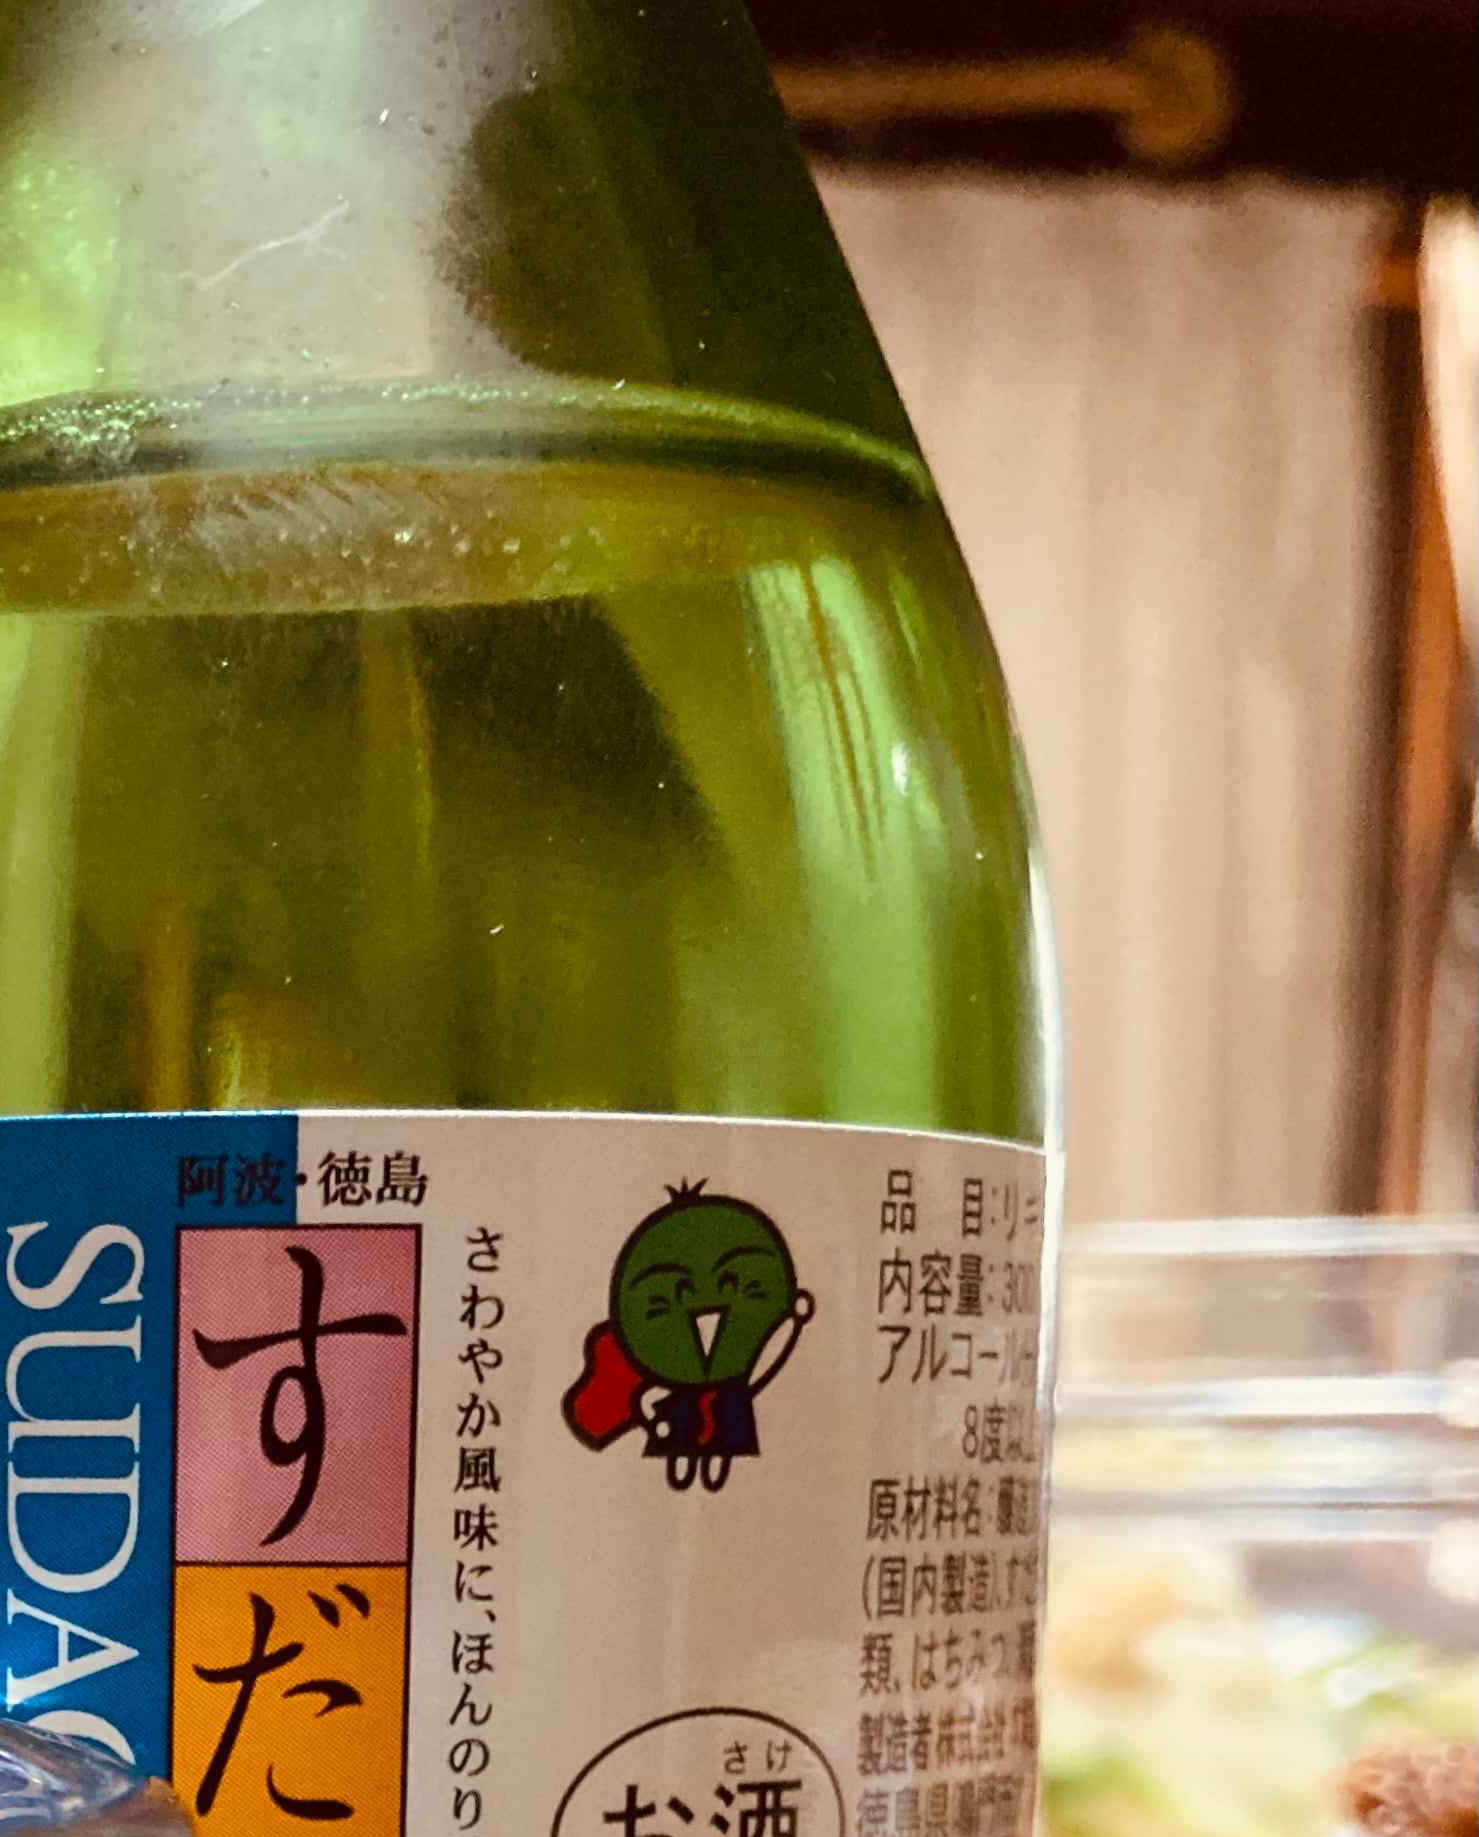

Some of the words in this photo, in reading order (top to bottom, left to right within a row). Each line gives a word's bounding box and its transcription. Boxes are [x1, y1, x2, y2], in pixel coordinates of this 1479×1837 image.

[176, 1151, 429, 1208] 阿波・徳島
[723, 1740, 793, 1775] さけ
